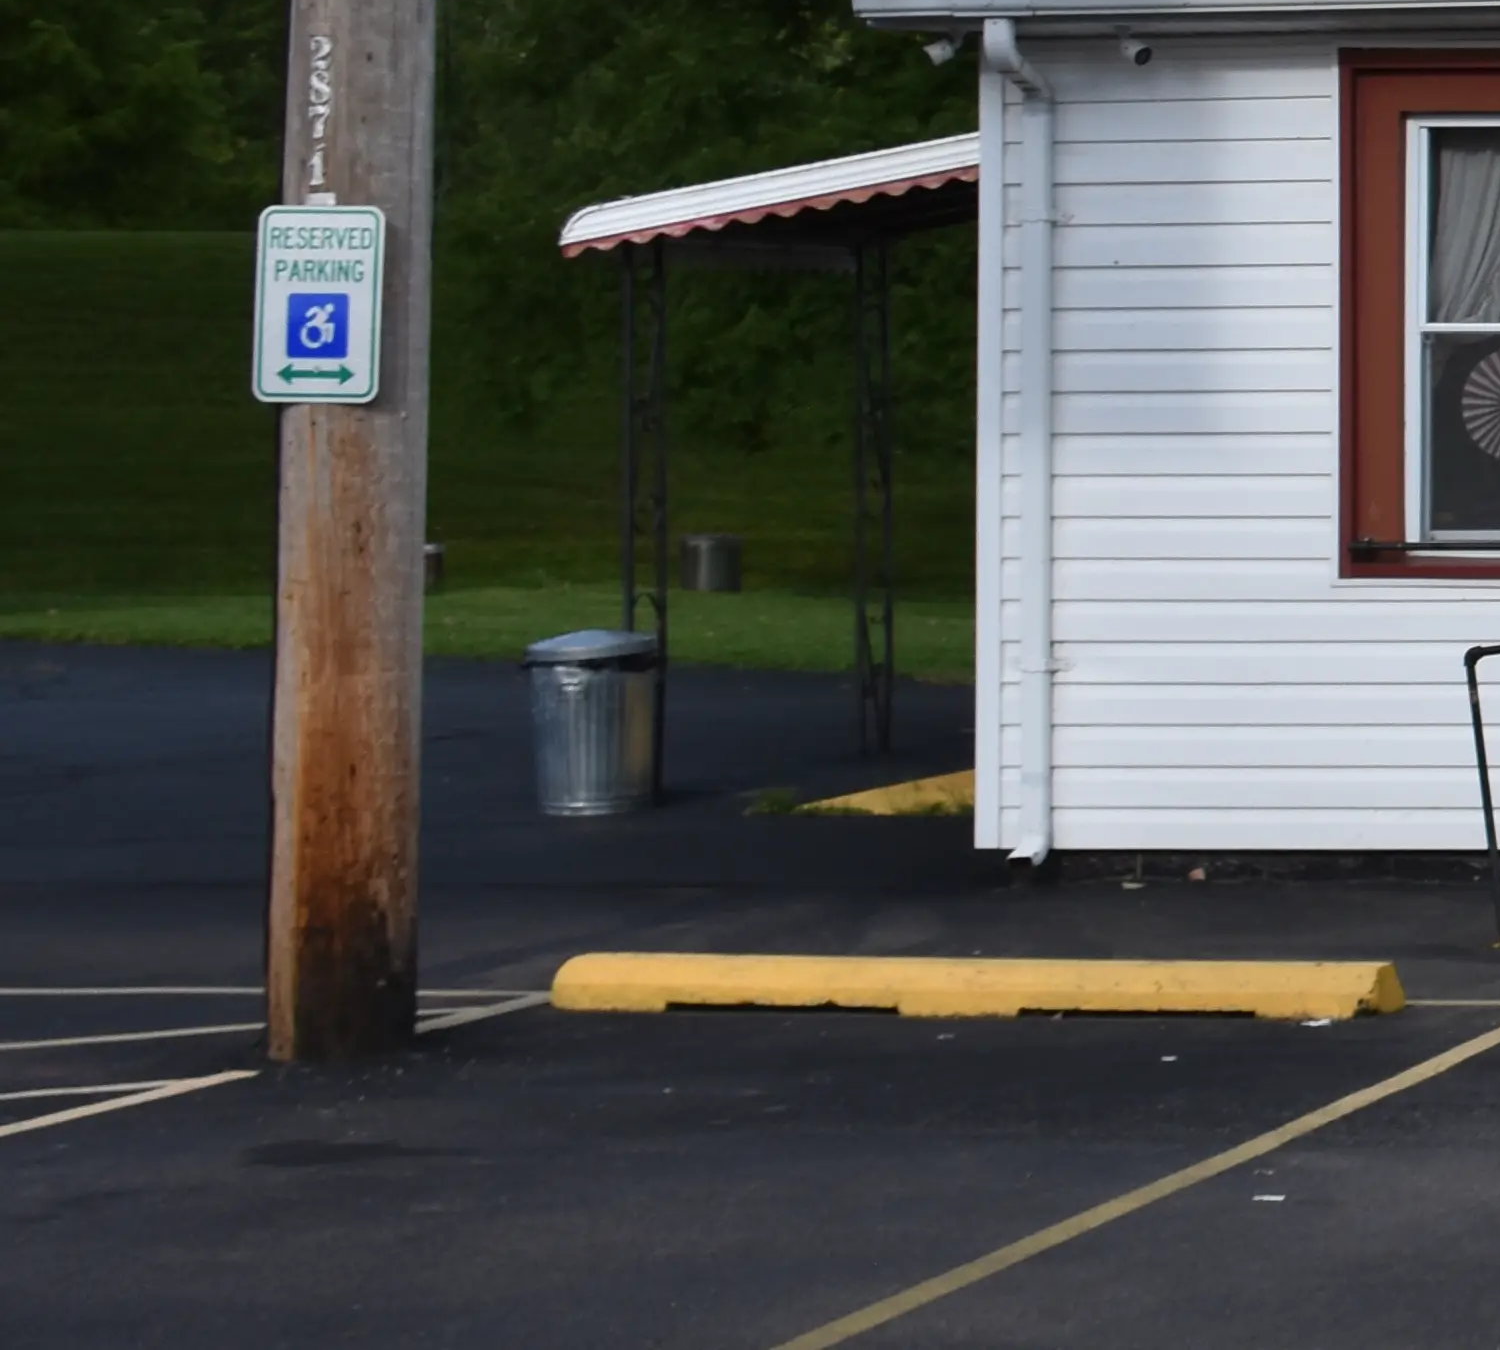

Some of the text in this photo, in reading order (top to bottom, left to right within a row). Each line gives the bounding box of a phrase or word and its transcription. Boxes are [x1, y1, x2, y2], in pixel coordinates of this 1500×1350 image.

[307, 35, 333, 186] 2871
[269, 226, 373, 251] RESERVED
[274, 259, 365, 284] PARKING
